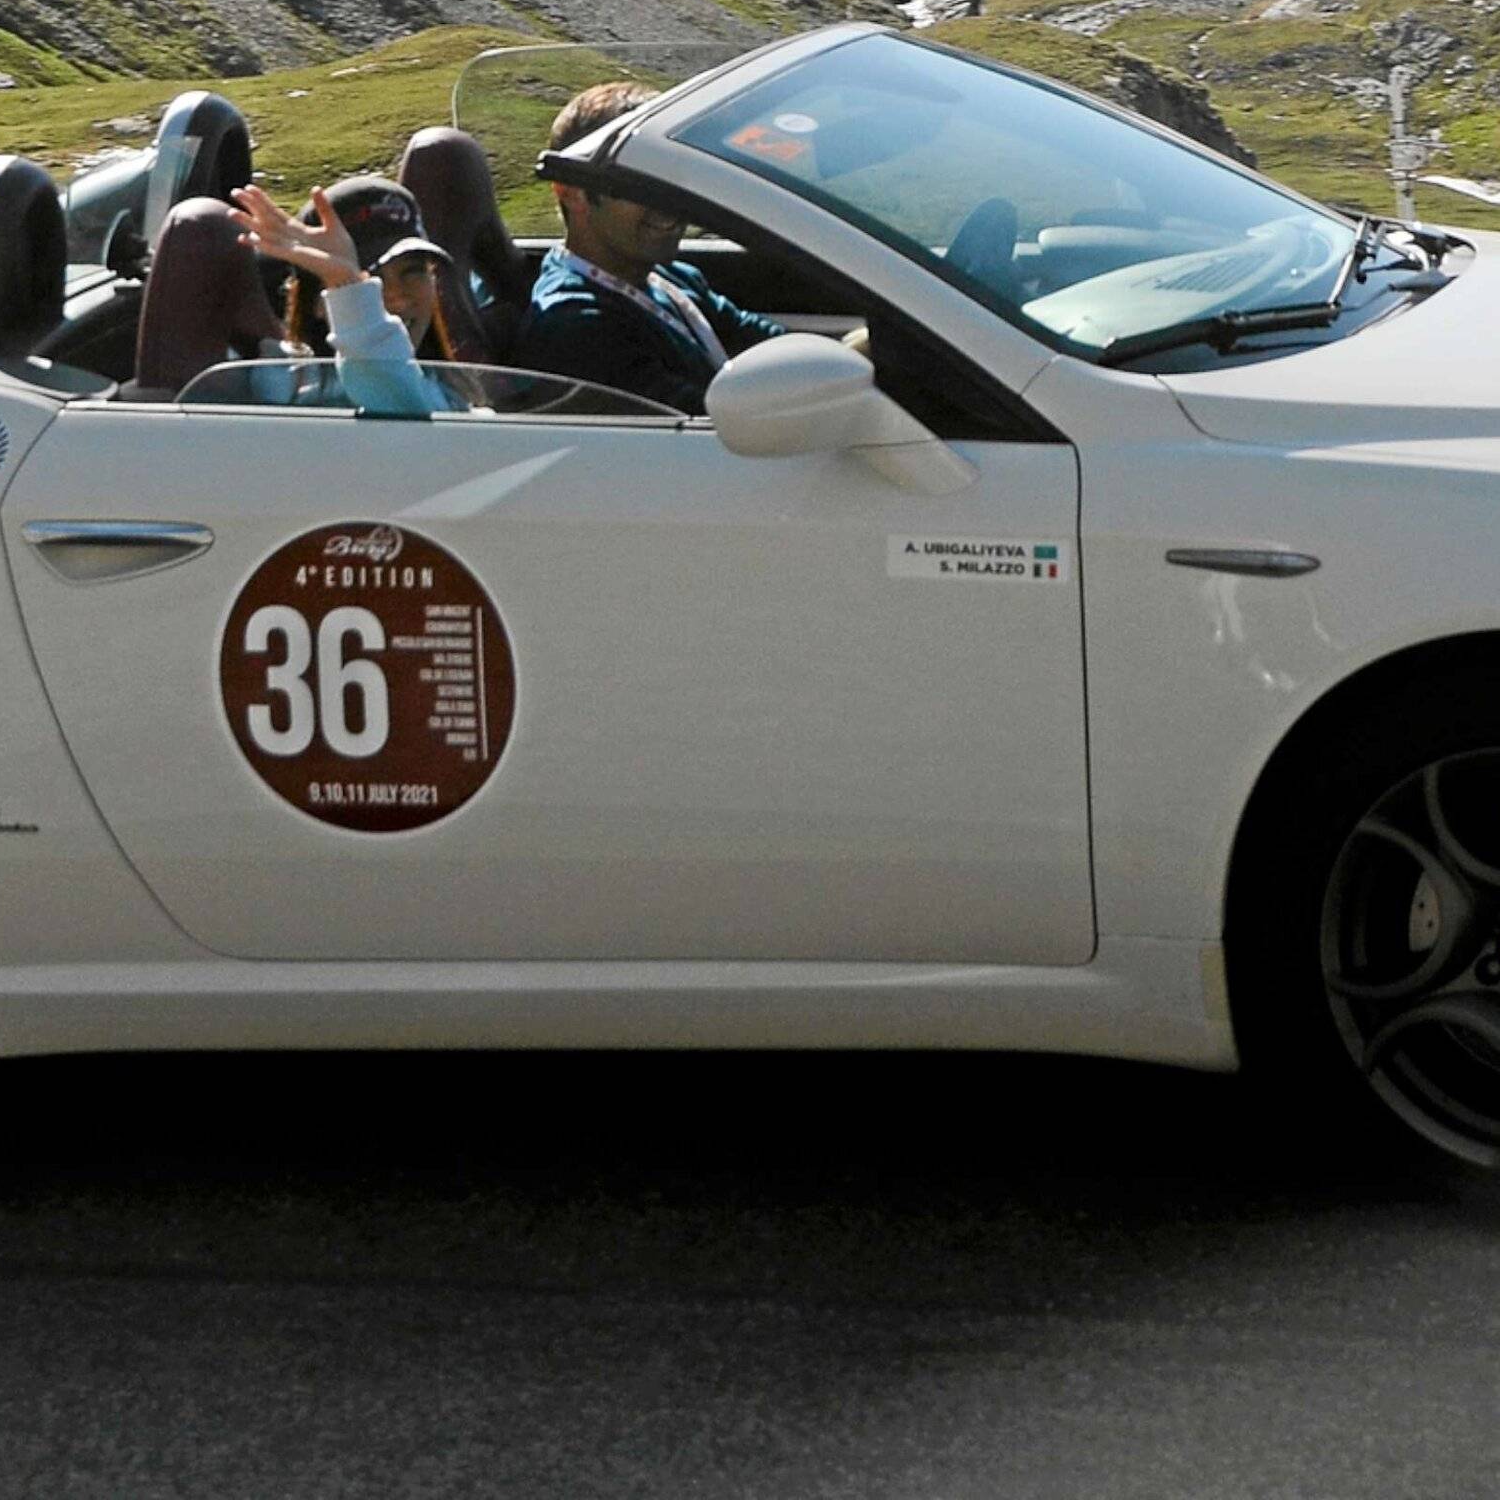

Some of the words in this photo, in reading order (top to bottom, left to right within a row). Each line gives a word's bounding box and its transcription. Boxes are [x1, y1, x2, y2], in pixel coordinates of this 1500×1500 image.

[905, 541, 919, 553] A.
[325, 566, 434, 588] EDITION
[940, 561, 953, 573] S.
[957, 561, 1026, 575] MILAZZO
[245, 605, 390, 758] 36
[368, 783, 398, 803] JULY
[400, 784, 438, 804] 2021
